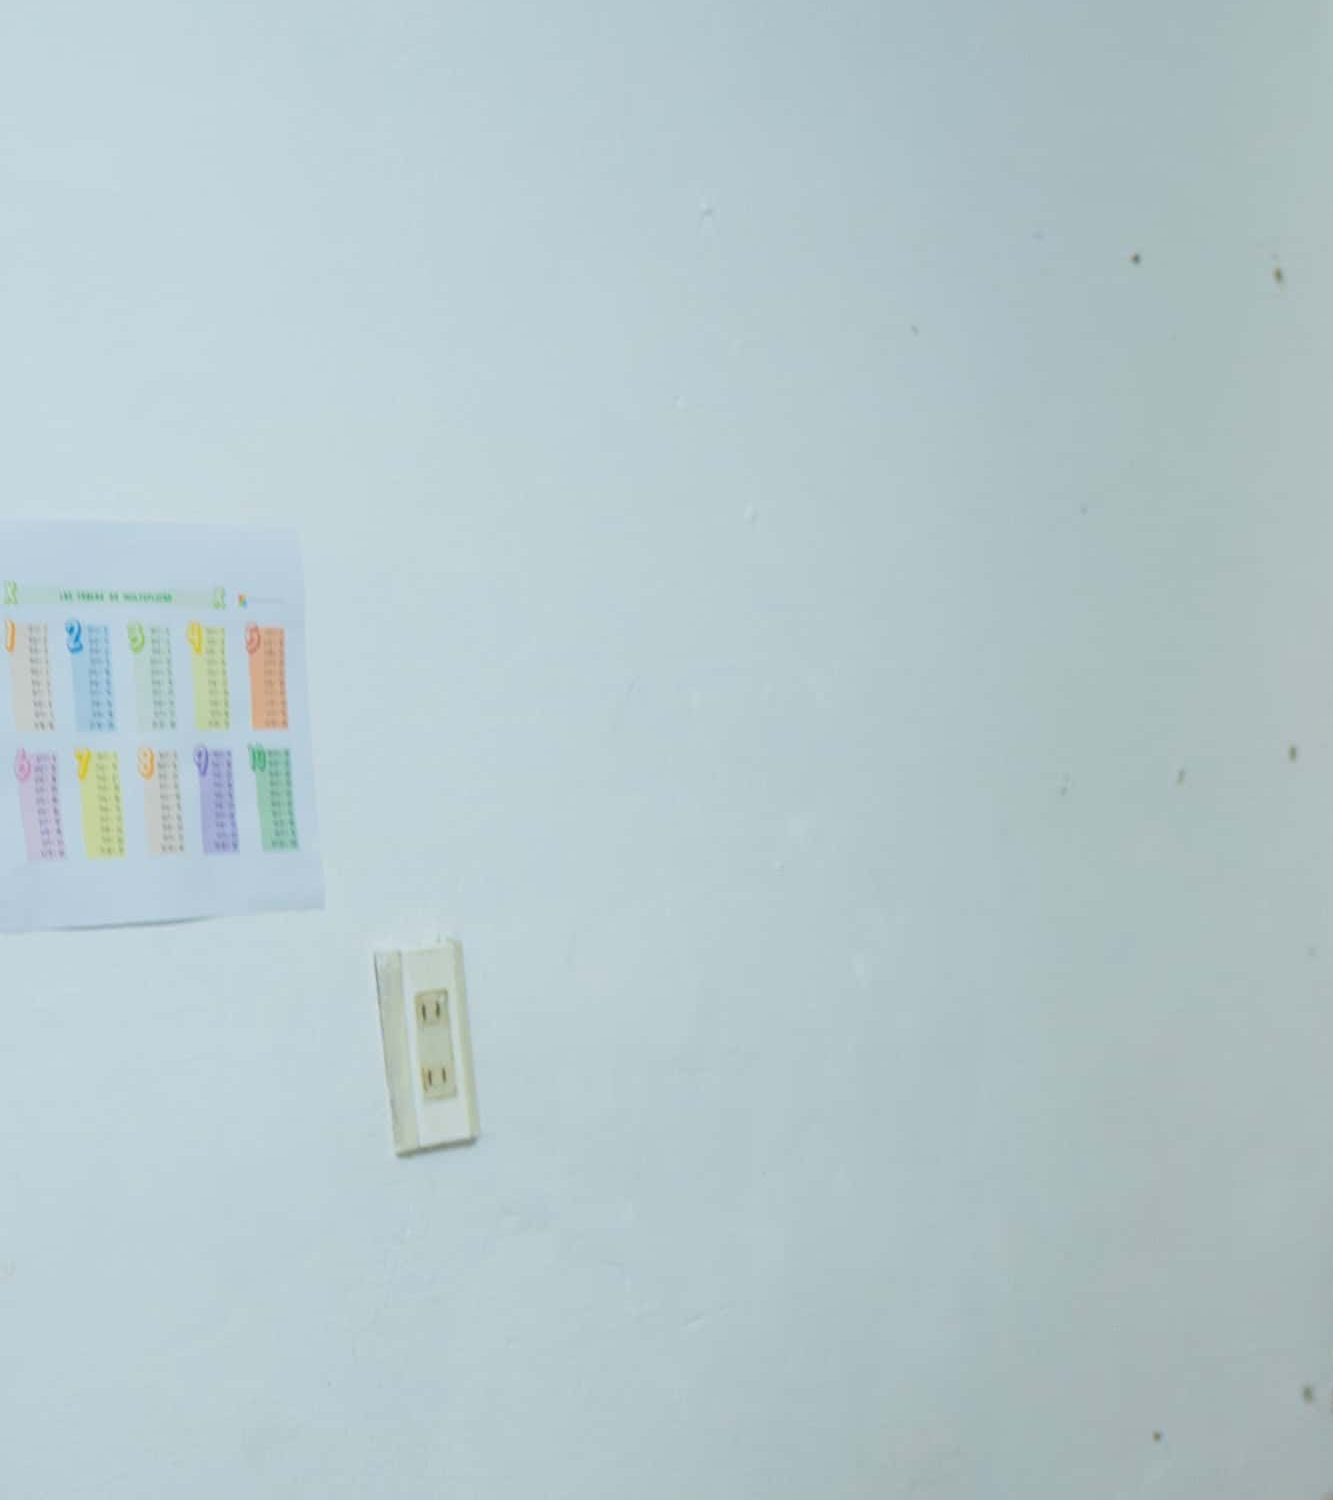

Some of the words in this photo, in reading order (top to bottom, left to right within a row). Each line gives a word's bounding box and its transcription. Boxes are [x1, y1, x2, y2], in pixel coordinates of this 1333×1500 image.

[4, 618, 16, 654] 1
[65, 619, 83, 655] 2
[128, 620, 145, 655] 3
[187, 621, 203, 656] 4
[15, 747, 32, 781] 6
[75, 747, 93, 781] 7
[193, 745, 209, 778] 9
